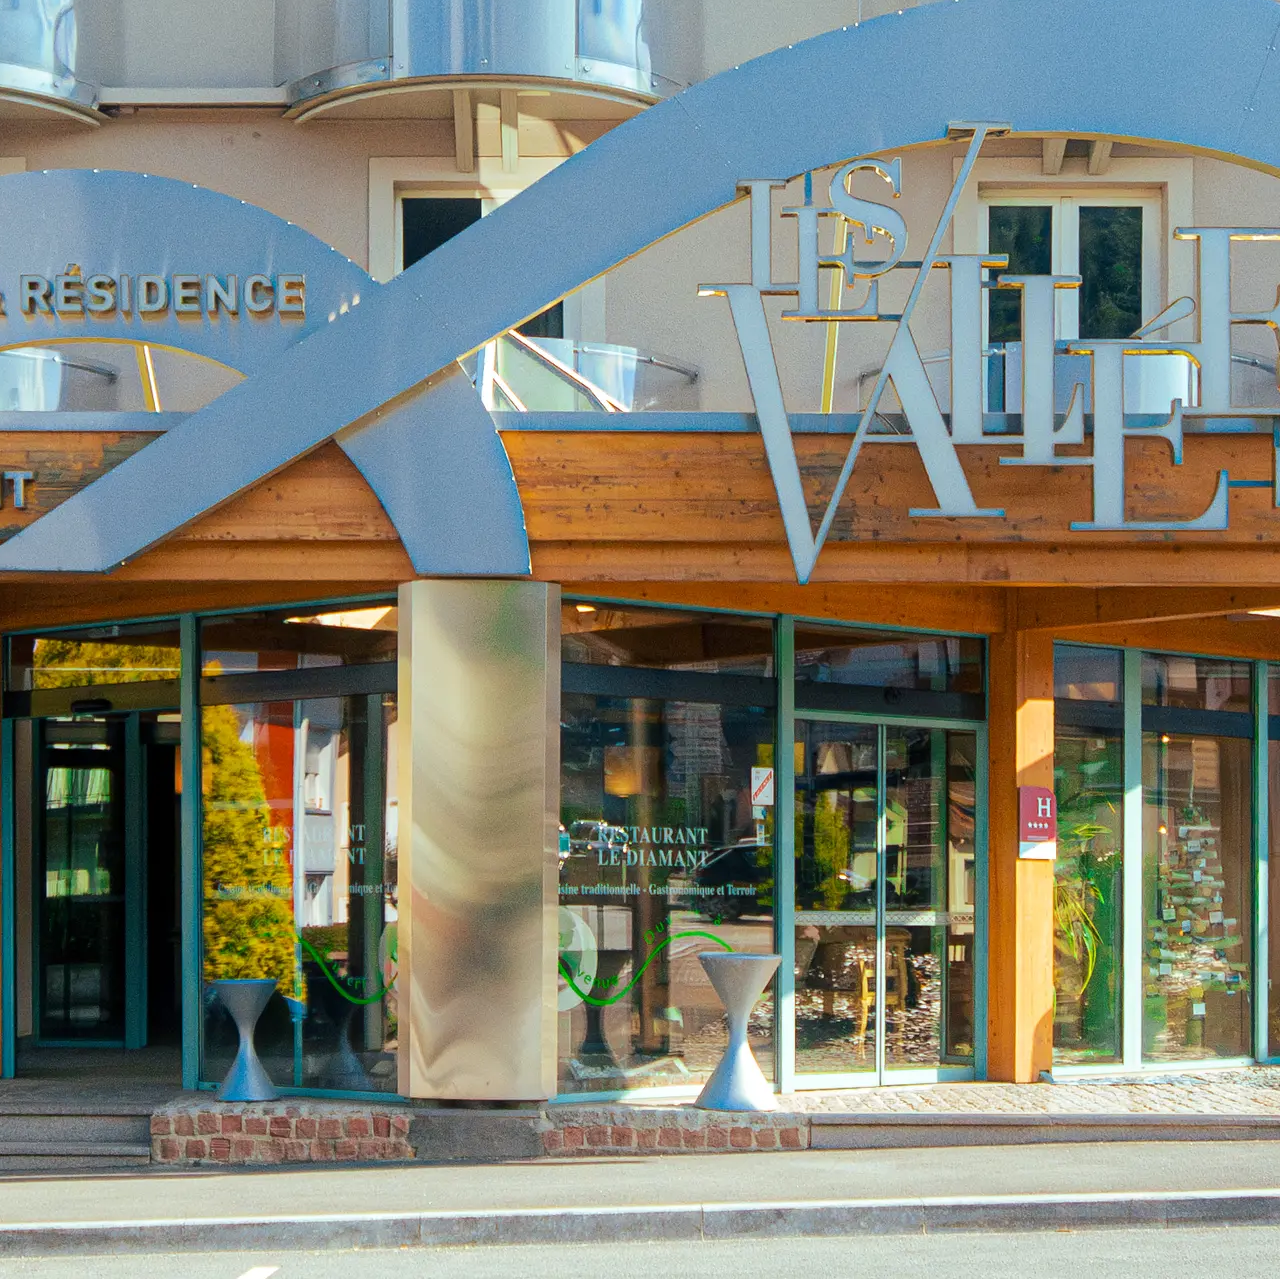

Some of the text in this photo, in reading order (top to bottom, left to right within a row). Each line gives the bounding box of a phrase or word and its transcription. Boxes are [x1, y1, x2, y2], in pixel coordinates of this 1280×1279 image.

[20, 262, 306, 318] RÉSIDENCE
[1037, 797, 1052, 818] H
[263, 824, 366, 844] RESAURNT
[598, 826, 708, 845] RESTAURANT
[598, 849, 710, 867] LE DIAMANT
[581, 883, 641, 895] traditionnelle
[716, 884, 726, 895] et
